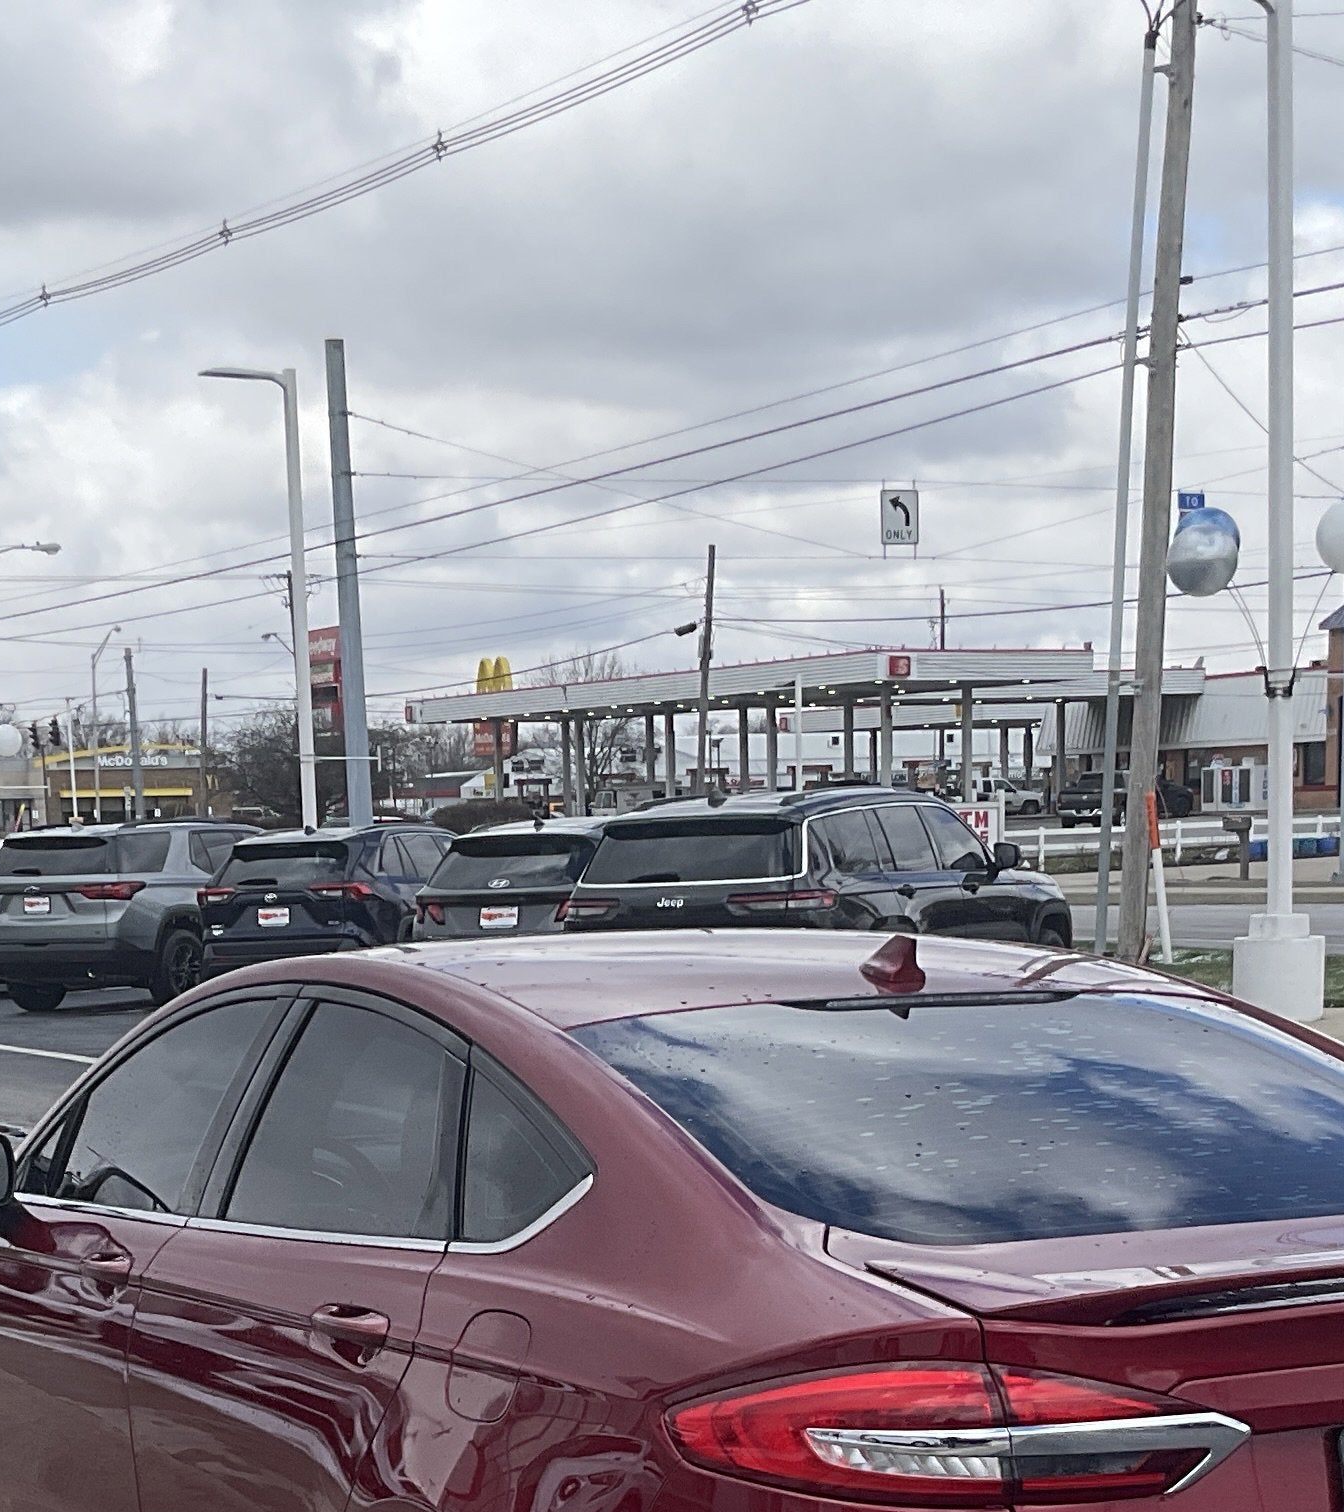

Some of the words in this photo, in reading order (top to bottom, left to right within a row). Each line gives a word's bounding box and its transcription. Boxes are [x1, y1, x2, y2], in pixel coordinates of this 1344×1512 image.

[886, 529, 912, 540] ONLY
[97, 755, 168, 767] McDoald's
[959, 810, 989, 828] TM
[656, 897, 684, 908] Jeep
